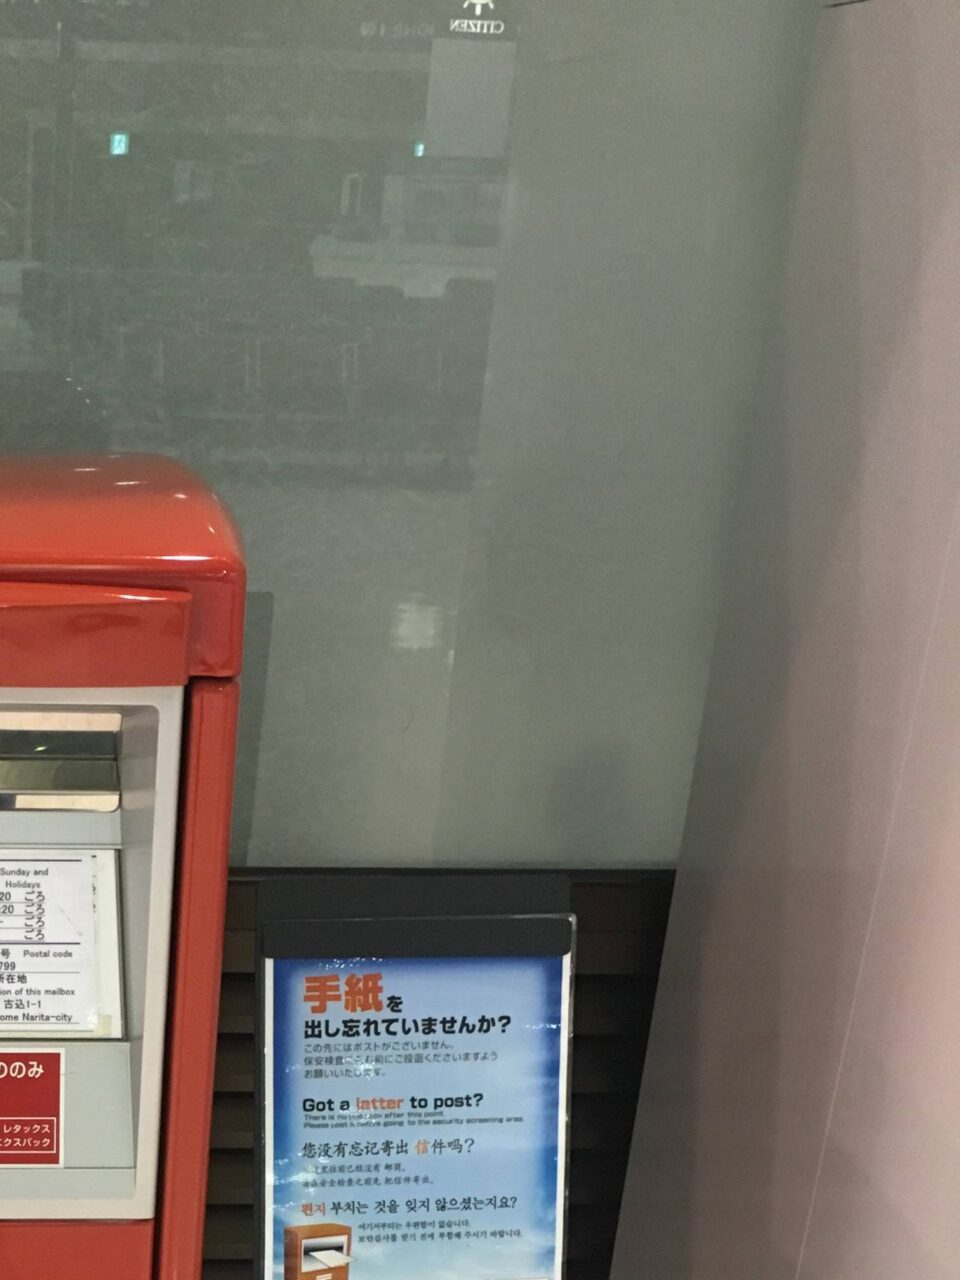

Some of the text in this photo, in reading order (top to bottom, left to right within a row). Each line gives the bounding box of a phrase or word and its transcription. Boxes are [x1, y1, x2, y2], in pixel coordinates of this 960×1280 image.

[0, 868, 31, 877] Sunday
[34, 868, 49, 876] and
[5, 881, 41, 889] Holidays
[24, 891, 46, 901] ごろ
[24, 903, 46, 914] ごろ
[24, 916, 46, 927] ごろ
[24, 929, 46, 940] ごろ
[23, 950, 50, 958] Postal
[53, 950, 73, 958] code
[15, 988, 23, 996] of
[26, 988, 41, 996] this
[44, 988, 75, 996] mailbox
[303, 972, 403, 1014] 手紙を
[4, 999, 41, 1009] 古込1-1
[22, 1013, 73, 1023] Narita-city
[304, 1015, 511, 1039] 出し忘れていませんか?
[304, 1041, 454, 1054] この先にはポストがございません。
[302, 1098, 334, 1112] Got
[340, 1100, 350, 1111] a
[410, 1096, 428, 1109] to
[433, 1093, 483, 1110] post?
[384, 1112, 404, 1120] after
[432, 1118, 464, 1126] security
[466, 1116, 504, 1124] screening
[303, 1138, 475, 1158] 您没有忘记寄出 信件吗?
[301, 1196, 517, 1216] 편지 부치는 것을 잊지 않으셨는지요?
